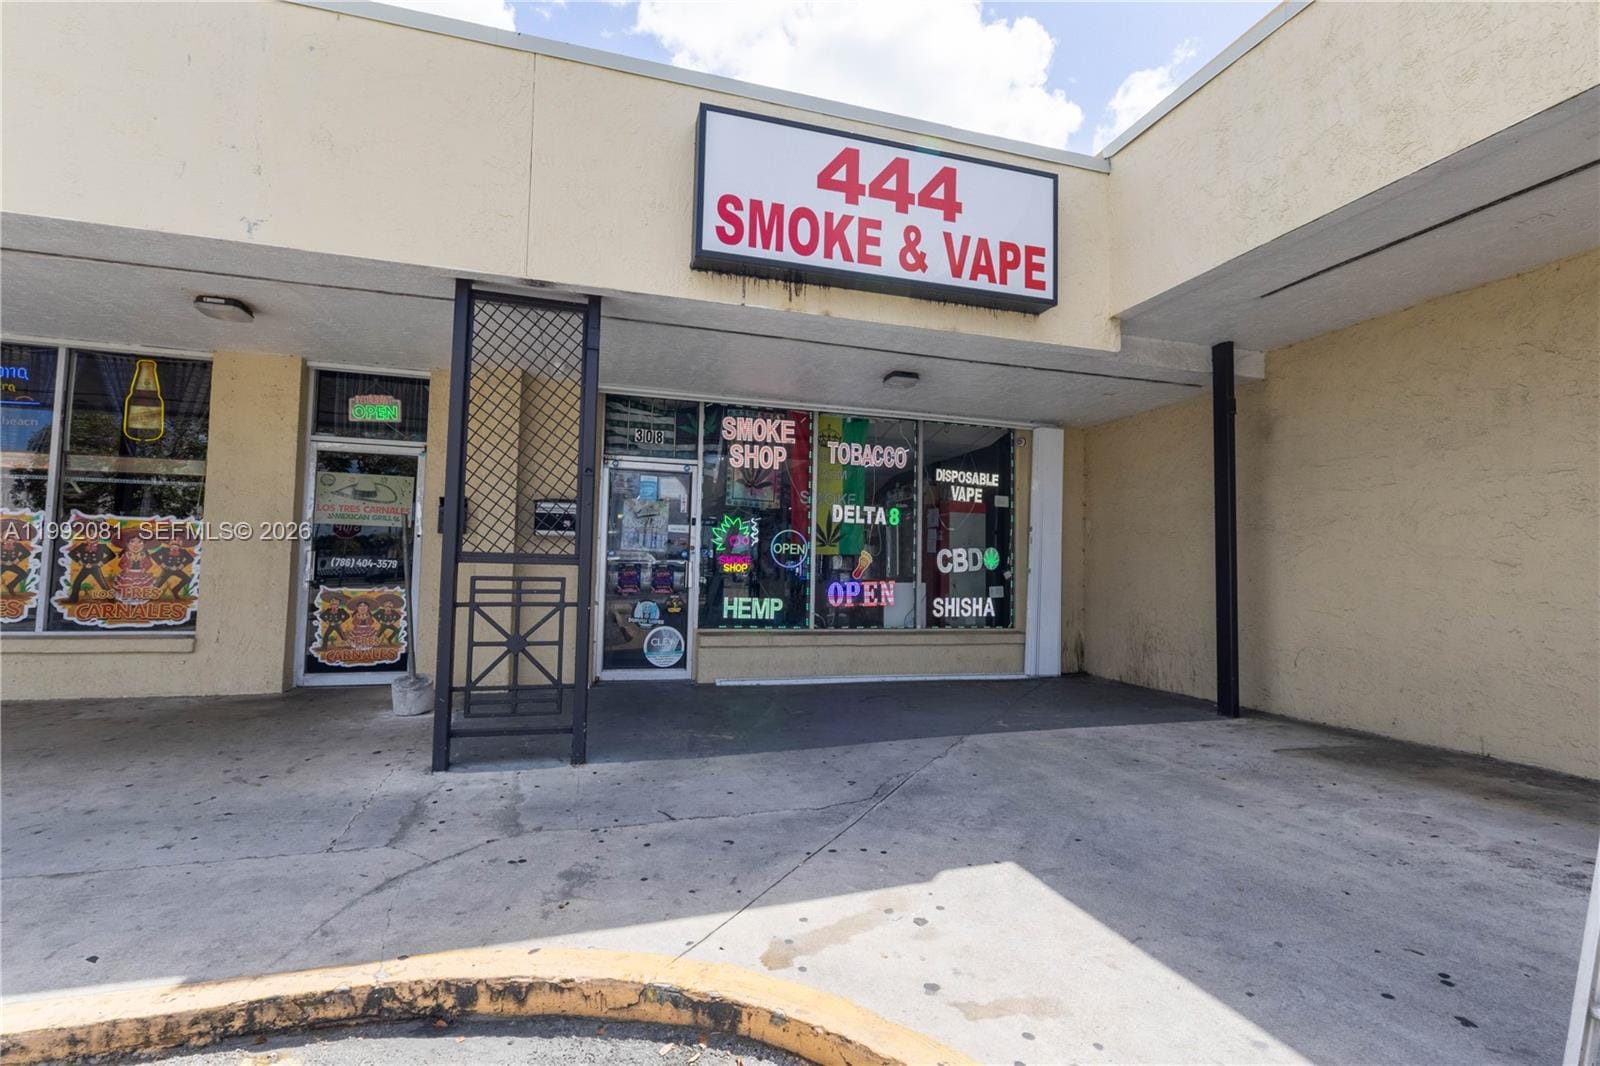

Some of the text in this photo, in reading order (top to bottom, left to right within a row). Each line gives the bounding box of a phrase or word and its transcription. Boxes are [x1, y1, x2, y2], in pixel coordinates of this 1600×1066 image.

[817, 147, 963, 223] 444
[715, 194, 1046, 291] SMOKE & VAPE
[352, 404, 398, 420] OPEN
[635, 428, 664, 444] 308
[721, 416, 796, 444] SMOKE
[729, 443, 787, 470] SHOP
[827, 441, 907, 469] TOBACCO
[936, 468, 999, 487] DISPOSABLE
[951, 485, 983, 503] VAPE
[316, 504, 411, 515] LOS TRES CARNALES
[773, 543, 806, 554] OPEN
[331, 557, 398, 569] (786) 404-3579
[723, 563, 748, 572] SHOP
[937, 547, 983, 573] CBD
[120, 586, 162, 599] TRES
[827, 580, 896, 607] OPEN
[75, 602, 188, 620] CARNALES
[723, 597, 783, 619] HEMP
[932, 597, 995, 618] SHISHA
